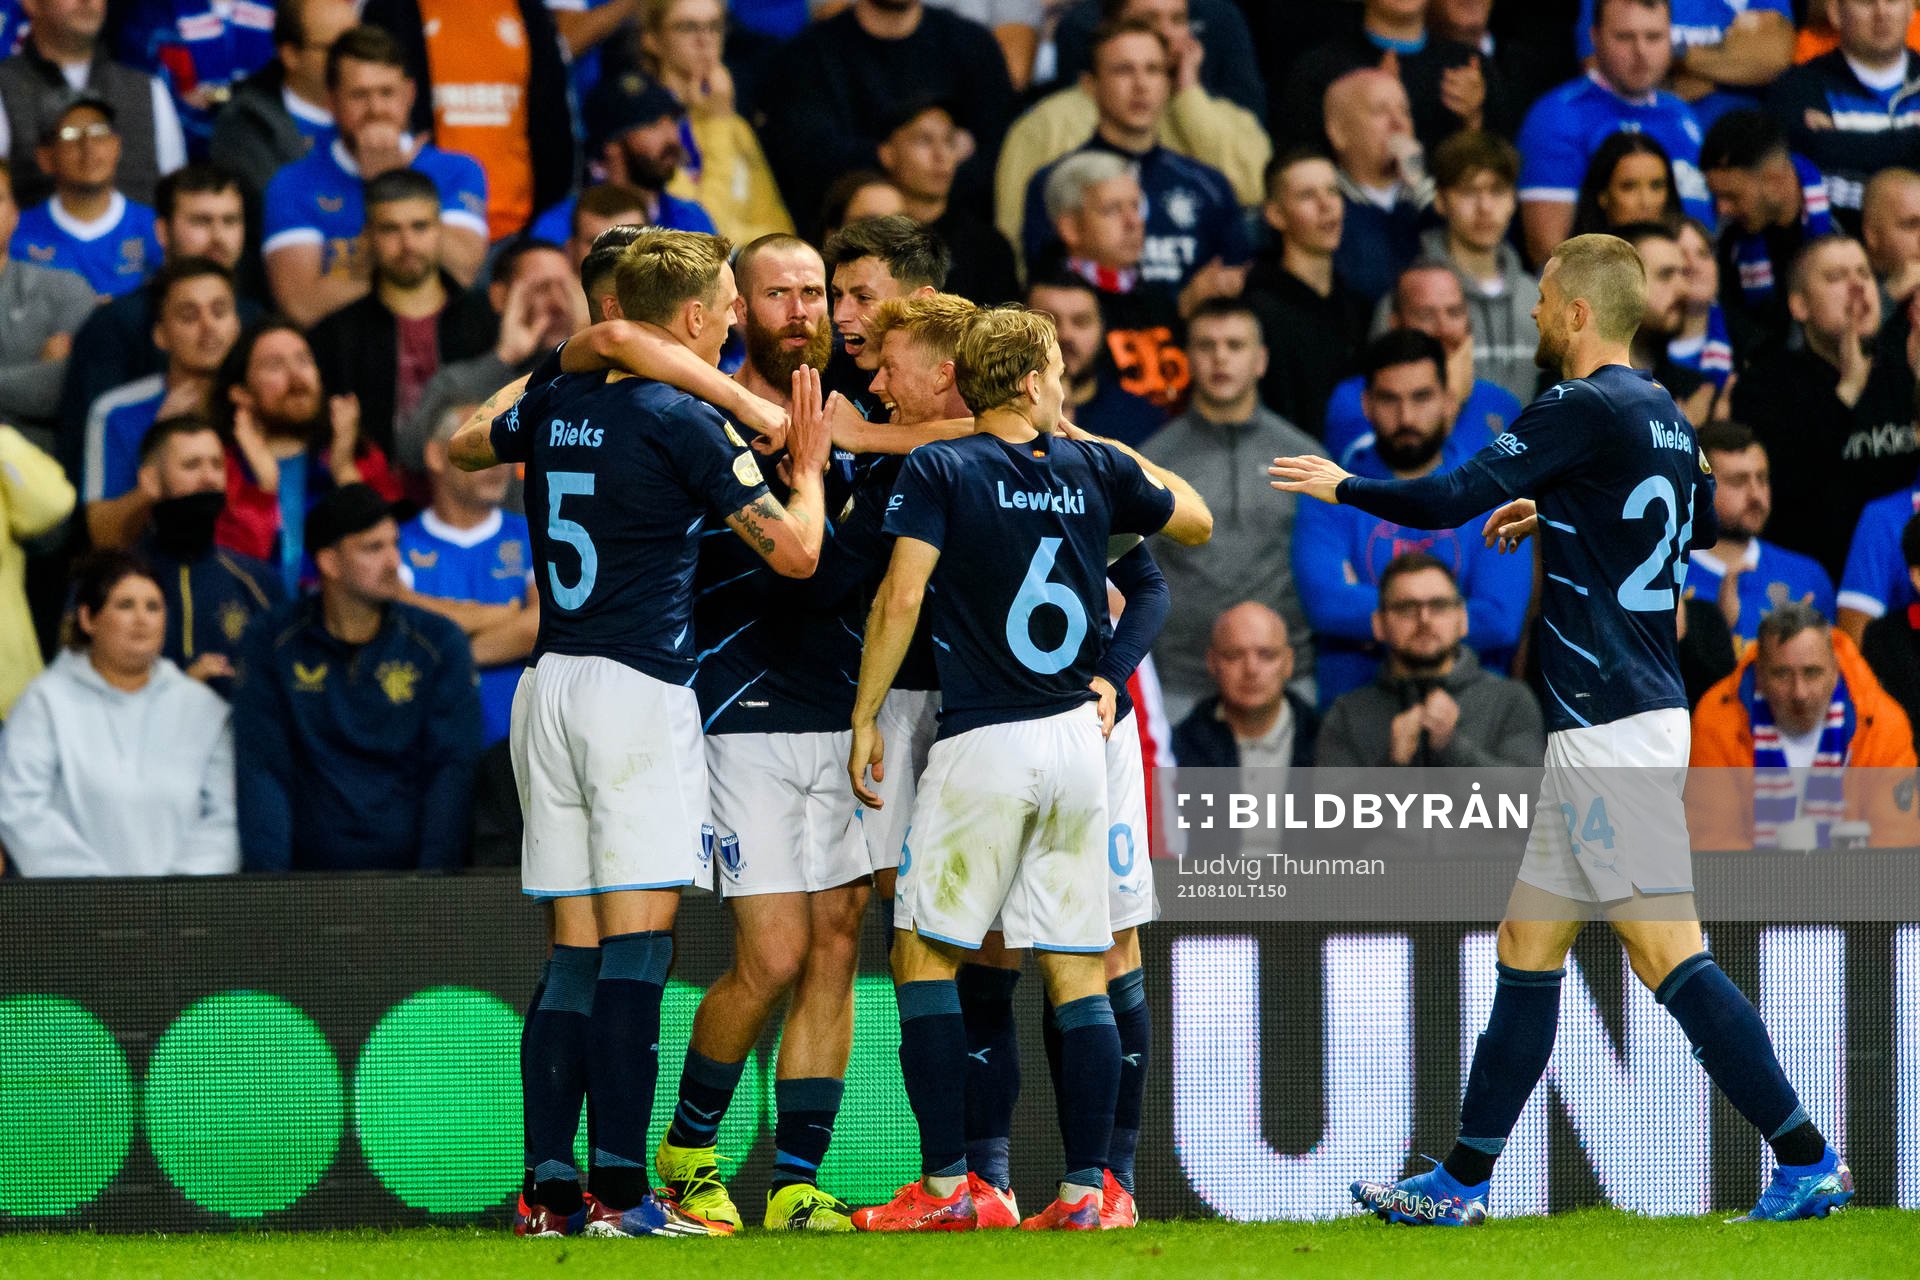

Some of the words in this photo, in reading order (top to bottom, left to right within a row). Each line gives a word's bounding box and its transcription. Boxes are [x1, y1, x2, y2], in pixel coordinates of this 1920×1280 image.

[549, 418, 605, 448] Rieks
[546, 471, 598, 611] 5
[1006, 536, 1088, 675] 6
[1171, 924, 1920, 1222] UNI
